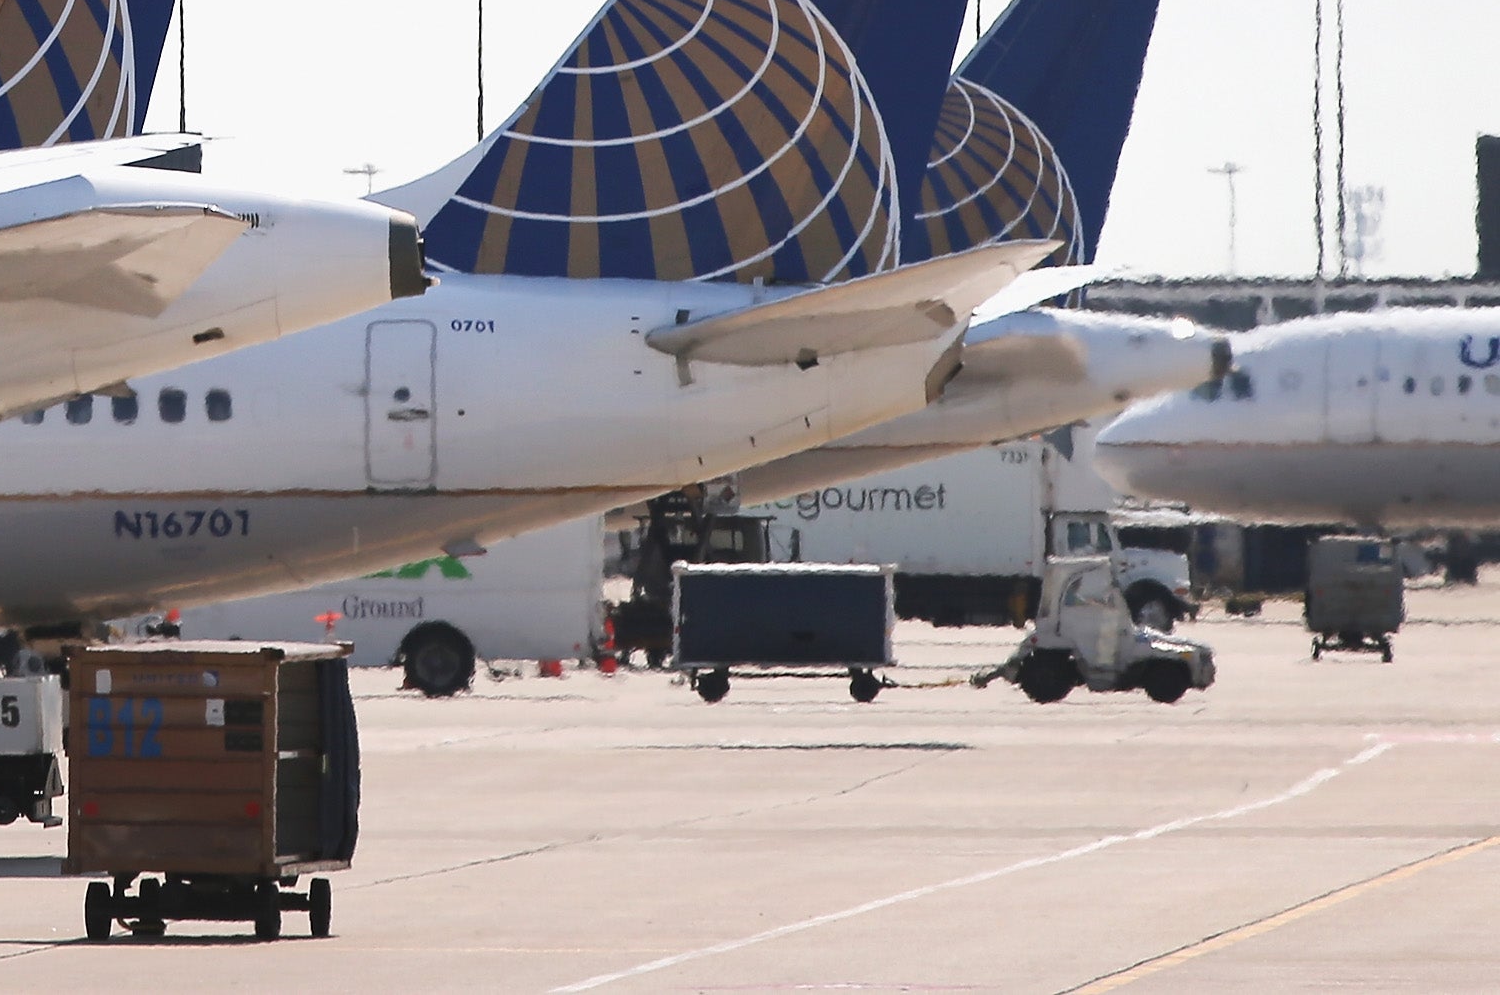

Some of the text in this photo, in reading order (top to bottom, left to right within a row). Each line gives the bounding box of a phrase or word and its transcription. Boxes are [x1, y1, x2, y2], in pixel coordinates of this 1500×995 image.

[451, 319, 494, 333] 0701
[114, 508, 249, 539] N16701
[342, 594, 424, 620] Ground
[88, 697, 163, 757] B12
